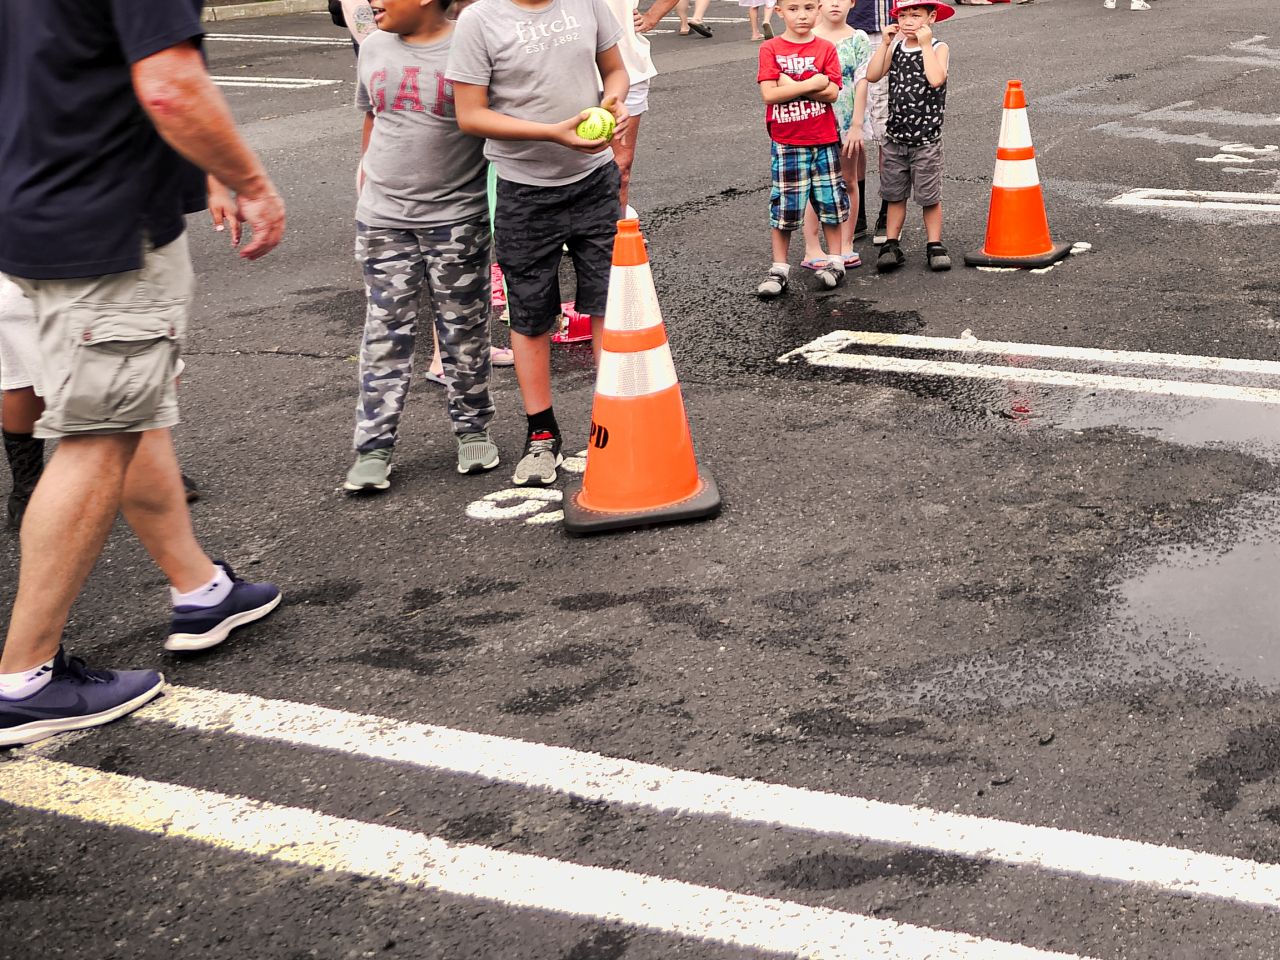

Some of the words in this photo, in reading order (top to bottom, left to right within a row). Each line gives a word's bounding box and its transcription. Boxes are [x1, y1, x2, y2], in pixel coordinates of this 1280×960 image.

[514, 10, 580, 43] fitch
[554, 32, 580, 47] 1892
[776, 55, 818, 74] FIRE
